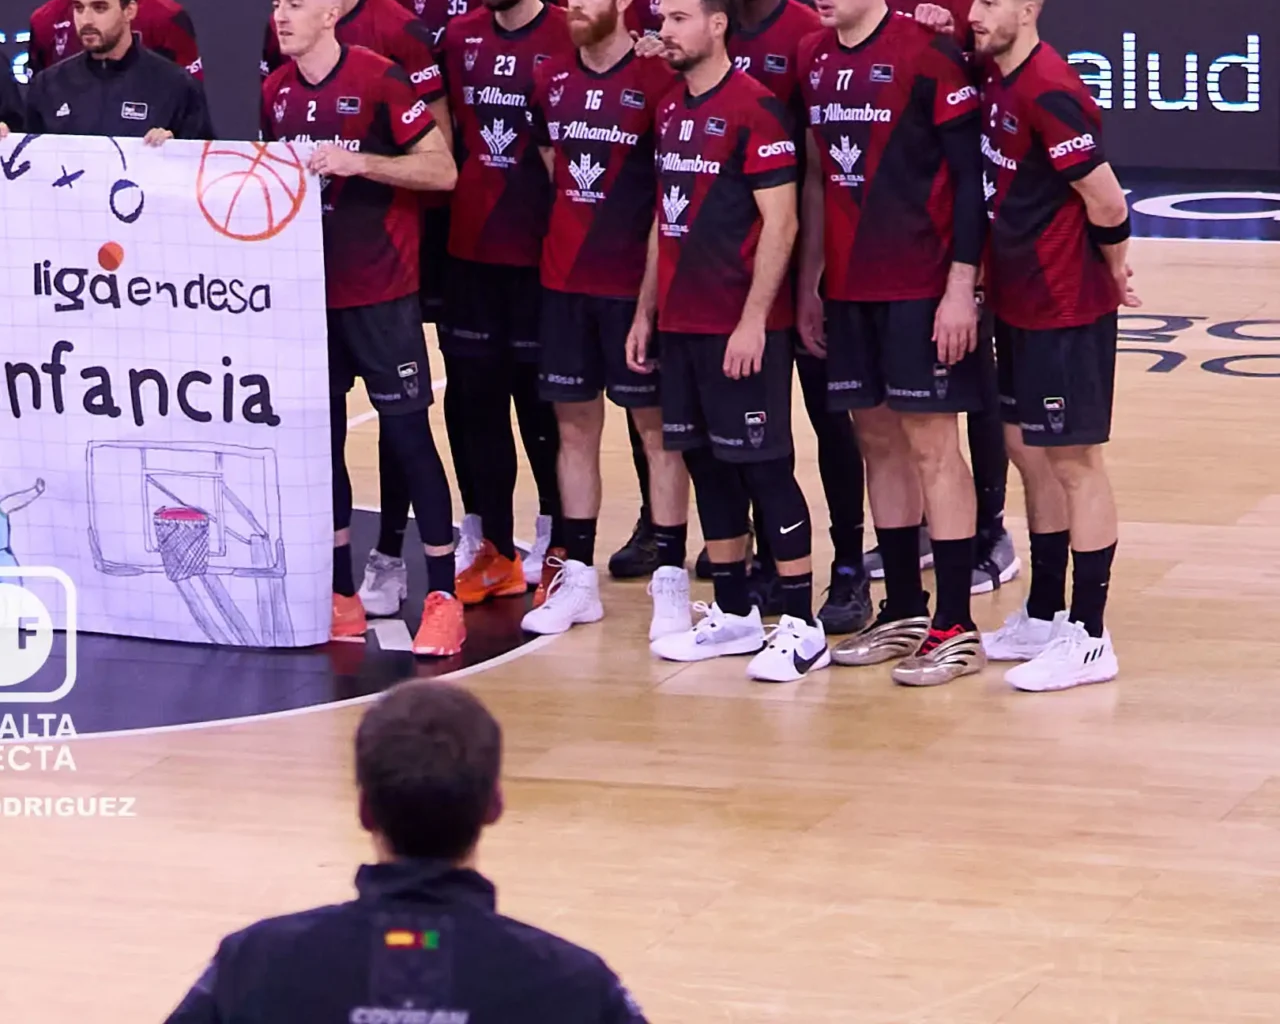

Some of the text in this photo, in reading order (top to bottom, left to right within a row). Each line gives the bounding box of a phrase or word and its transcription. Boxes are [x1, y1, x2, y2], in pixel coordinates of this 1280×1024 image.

[494, 55, 516, 76] 23
[836, 68, 853, 91] 77
[584, 89, 603, 110] 16
[306, 100, 316, 122] 2
[823, 103, 891, 123] Alhambra
[563, 121, 639, 146] Alhambra
[679, 119, 694, 142] 10
